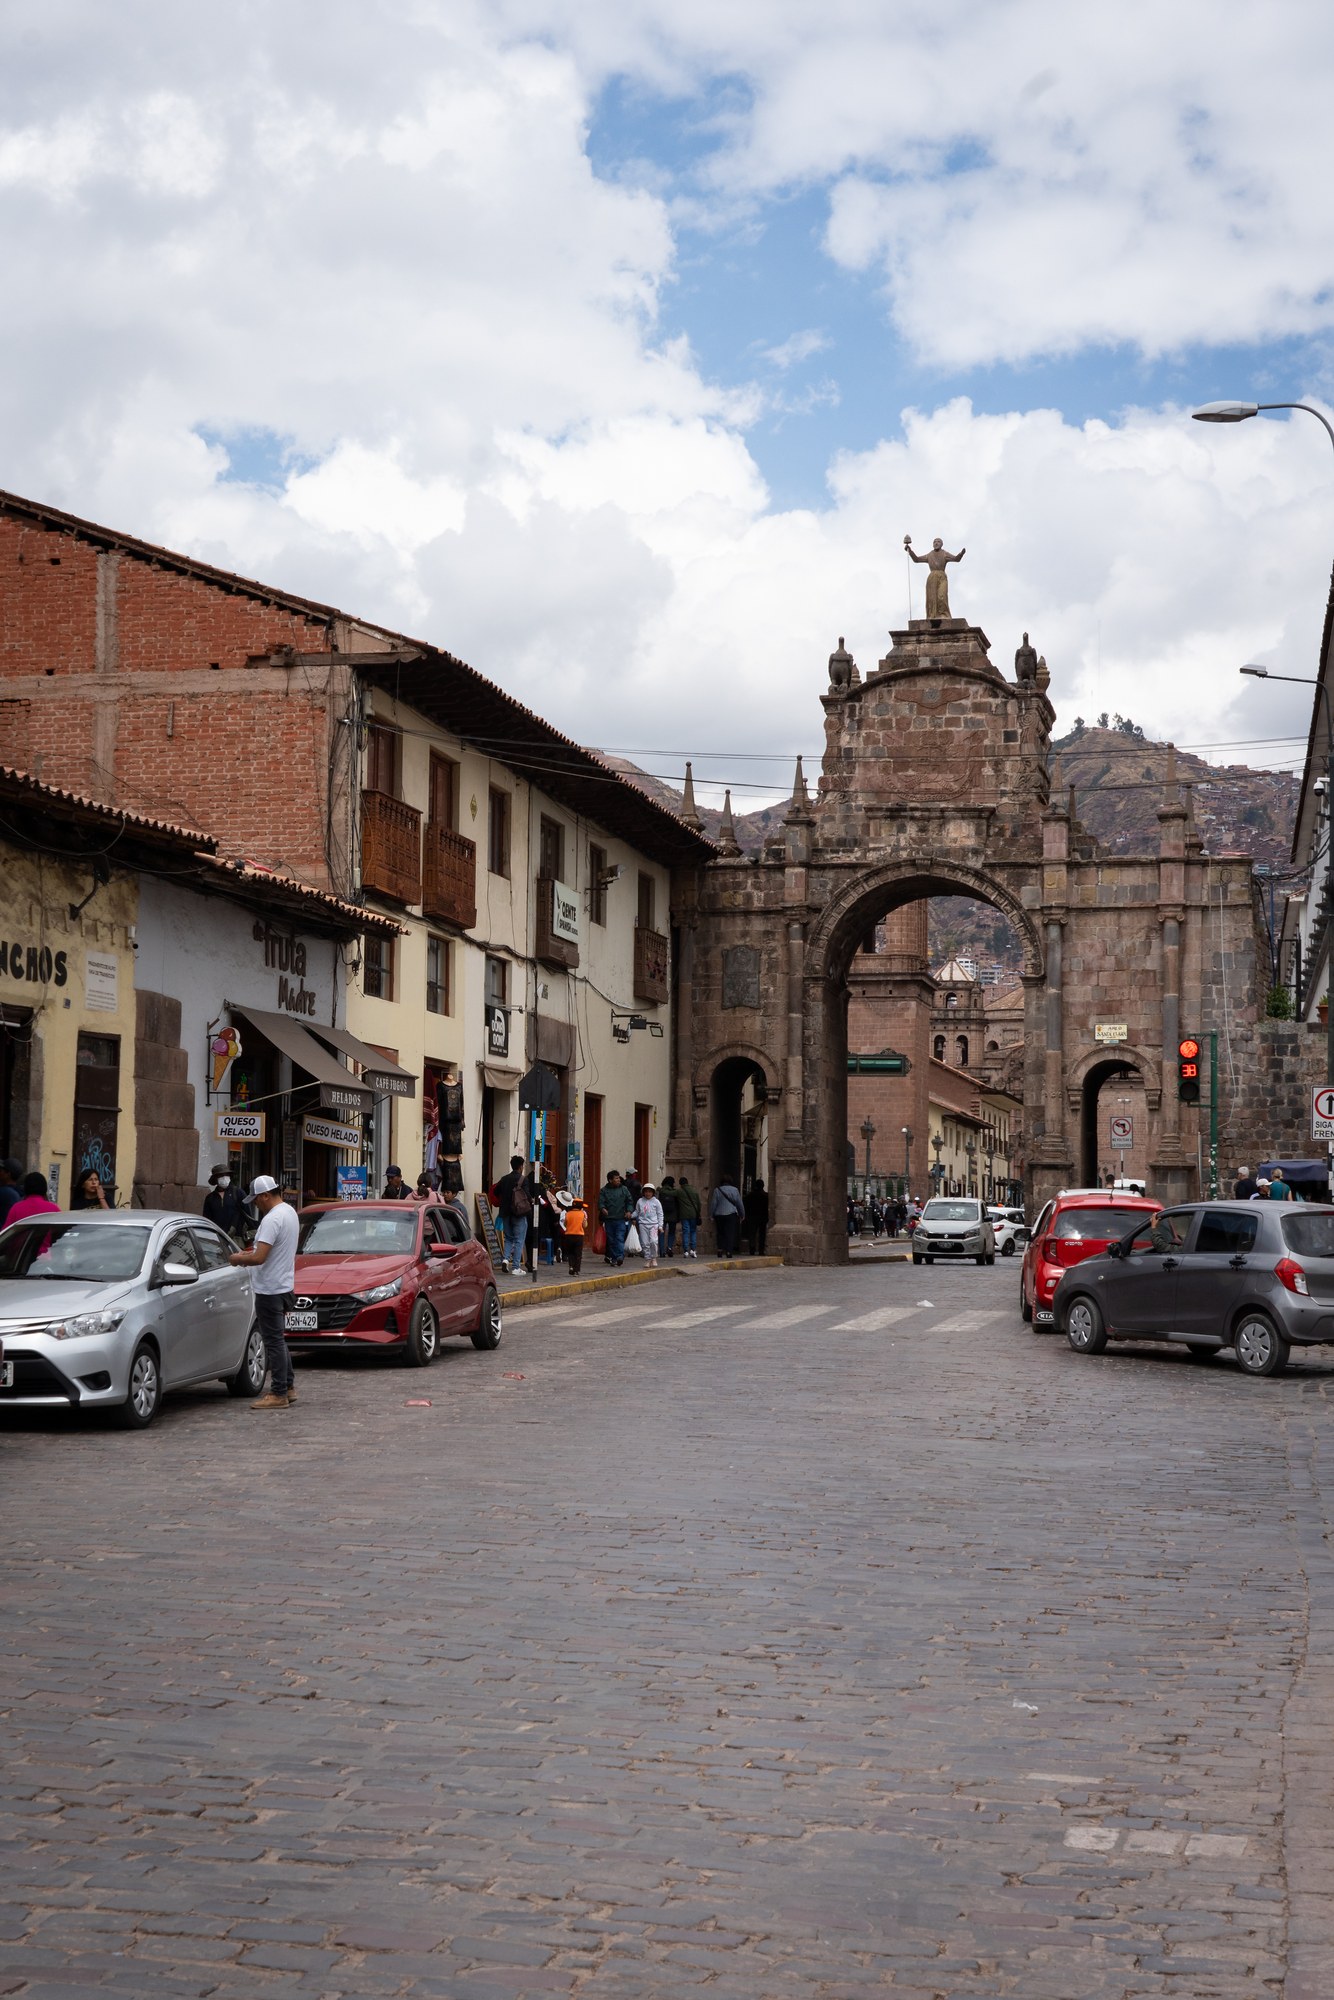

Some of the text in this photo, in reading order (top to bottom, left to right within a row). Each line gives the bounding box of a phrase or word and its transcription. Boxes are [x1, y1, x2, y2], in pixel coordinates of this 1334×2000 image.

[1182, 1064, 1197, 1077] 38
[390, 1079, 408, 1092] JUGOS
[331, 1091, 361, 1106] HELADOS
[223, 1116, 256, 1127] QUESO
[1315, 1121, 1333, 1129] SIGA
[219, 1128, 259, 1137] HELADO
[305, 1122, 359, 1144] QUESO HELADO
[286, 1315, 317, 1327] X5N-429
